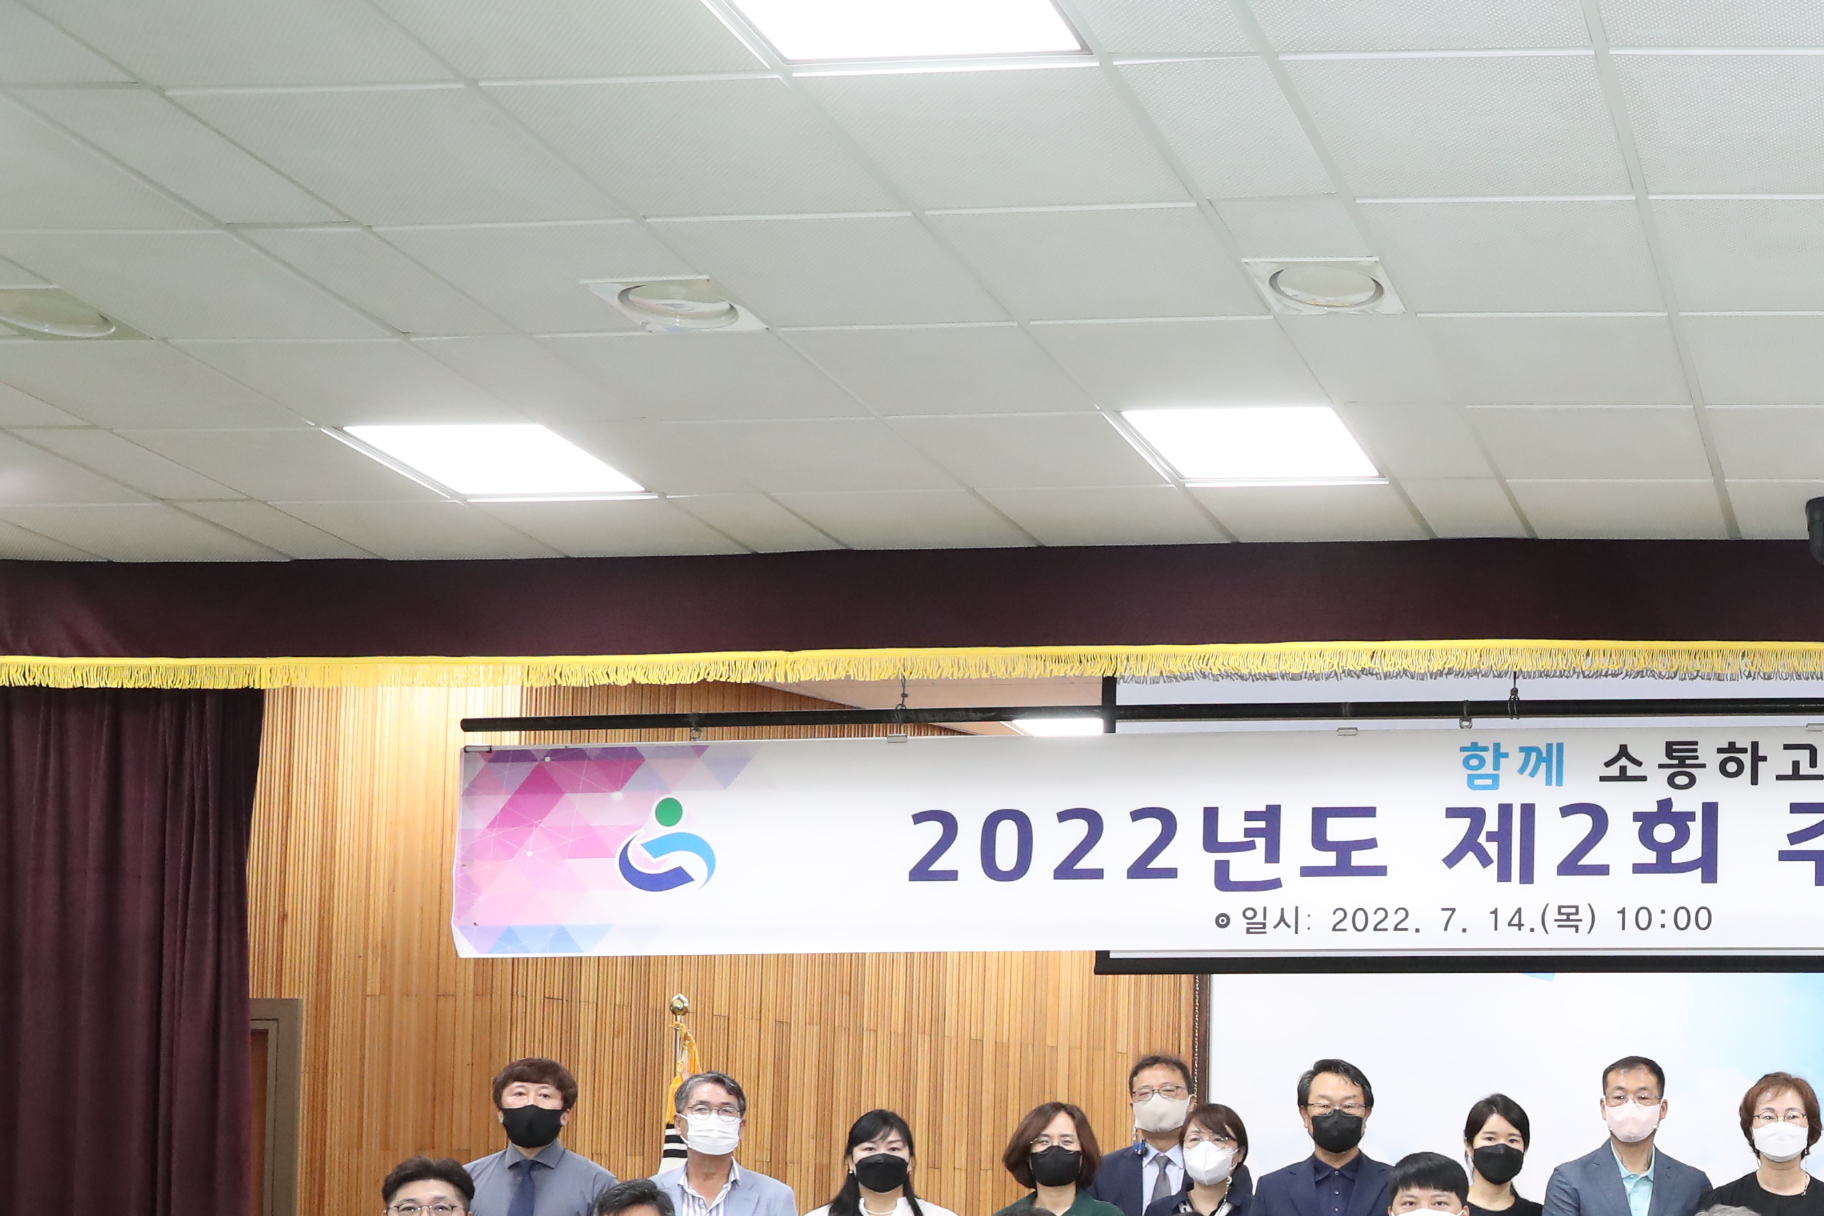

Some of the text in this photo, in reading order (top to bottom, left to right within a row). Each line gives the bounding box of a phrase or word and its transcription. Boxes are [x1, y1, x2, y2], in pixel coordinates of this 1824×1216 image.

[1459, 741, 1565, 791] 함께
[1598, 740, 1824, 791] 소통하고
[908, 803, 1389, 893] 2022년도
[1441, 796, 1720, 886] 제2회
[1241, 902, 1713, 936] 일시: 2022. 7. 14.(목) 10:00
